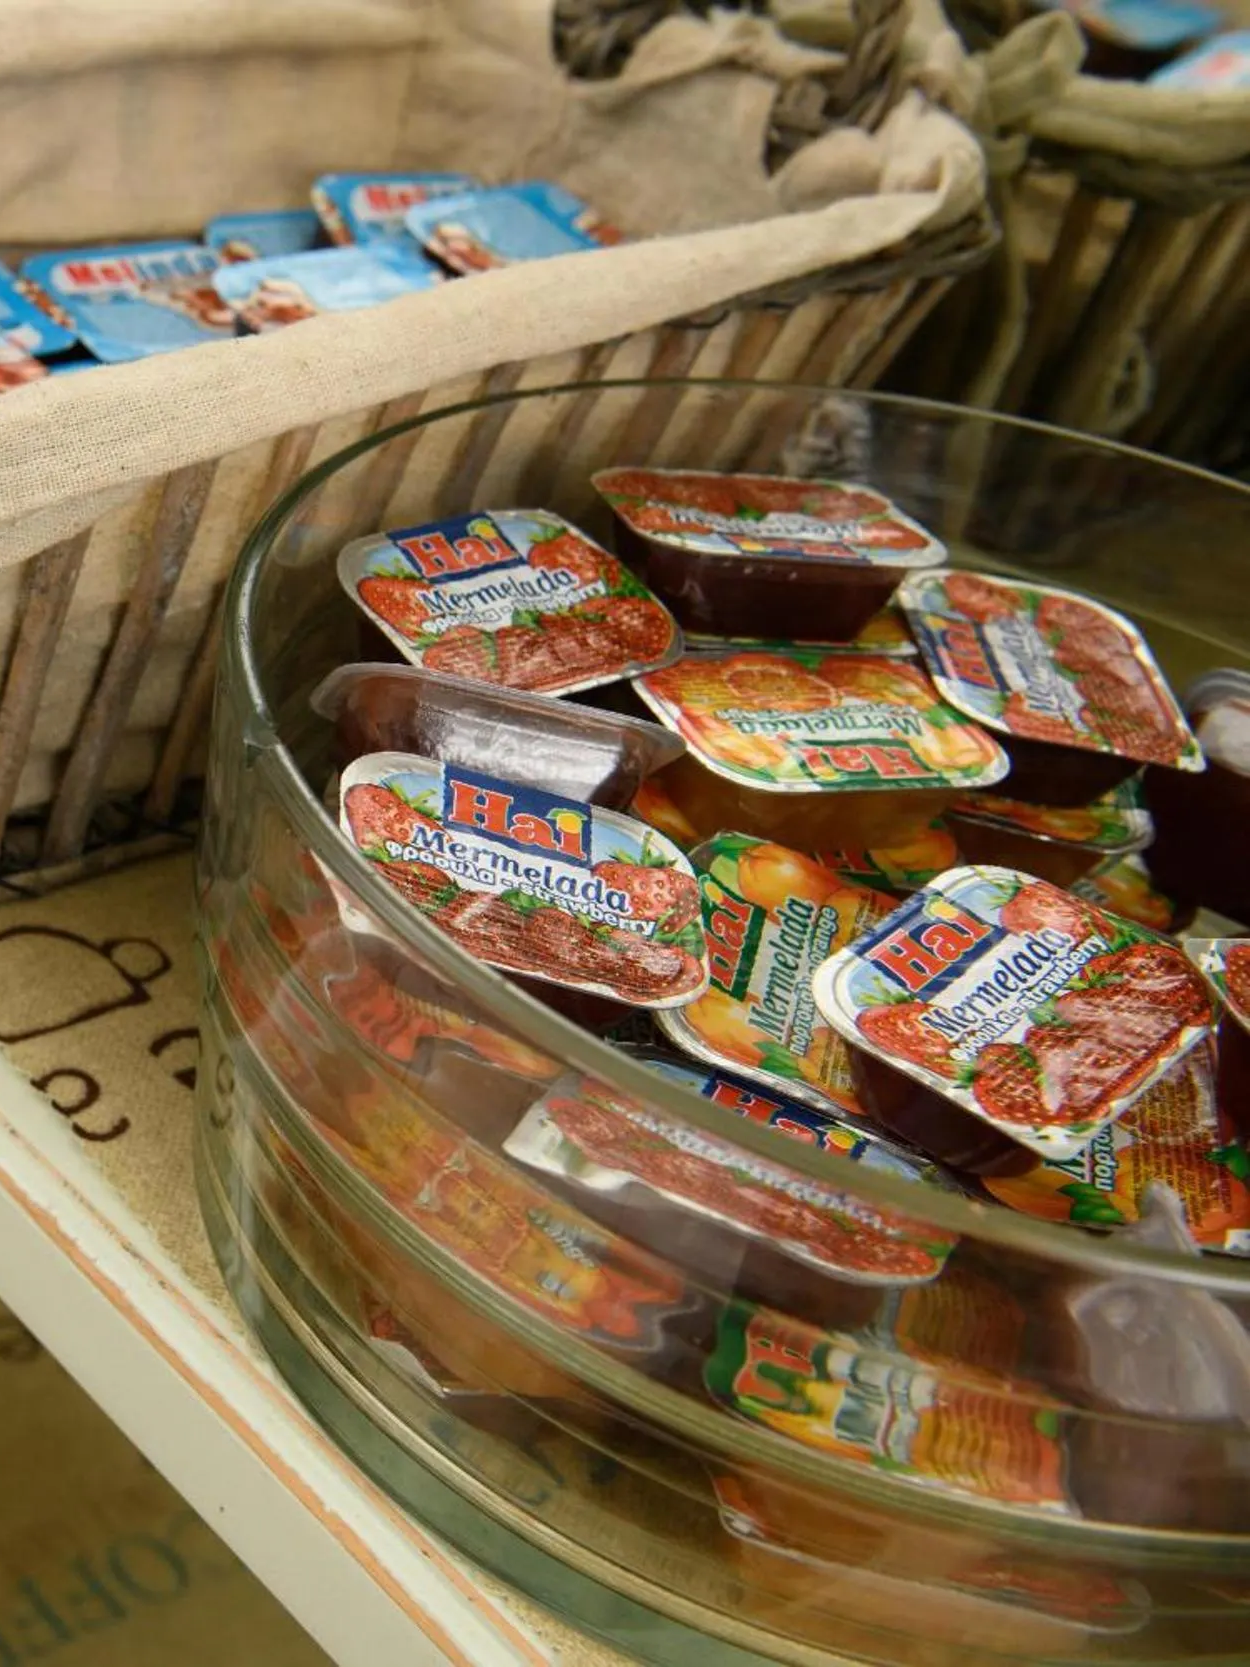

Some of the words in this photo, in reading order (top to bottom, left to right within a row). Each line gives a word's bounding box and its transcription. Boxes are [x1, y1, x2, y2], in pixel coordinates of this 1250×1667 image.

[399, 519, 519, 578] Hai
[420, 566, 576, 617] Mermelada
[733, 713, 923, 738] Mermelada
[798, 745, 938, 782] Hai
[449, 780, 586, 861] Hai
[411, 824, 633, 915] Mermelada
[520, 879, 659, 937] strawberry
[870, 898, 992, 994] Hai
[750, 896, 814, 1043] Mermelada
[920, 927, 1073, 1039] Mermelada
[1023, 935, 1110, 1011] strawberry
